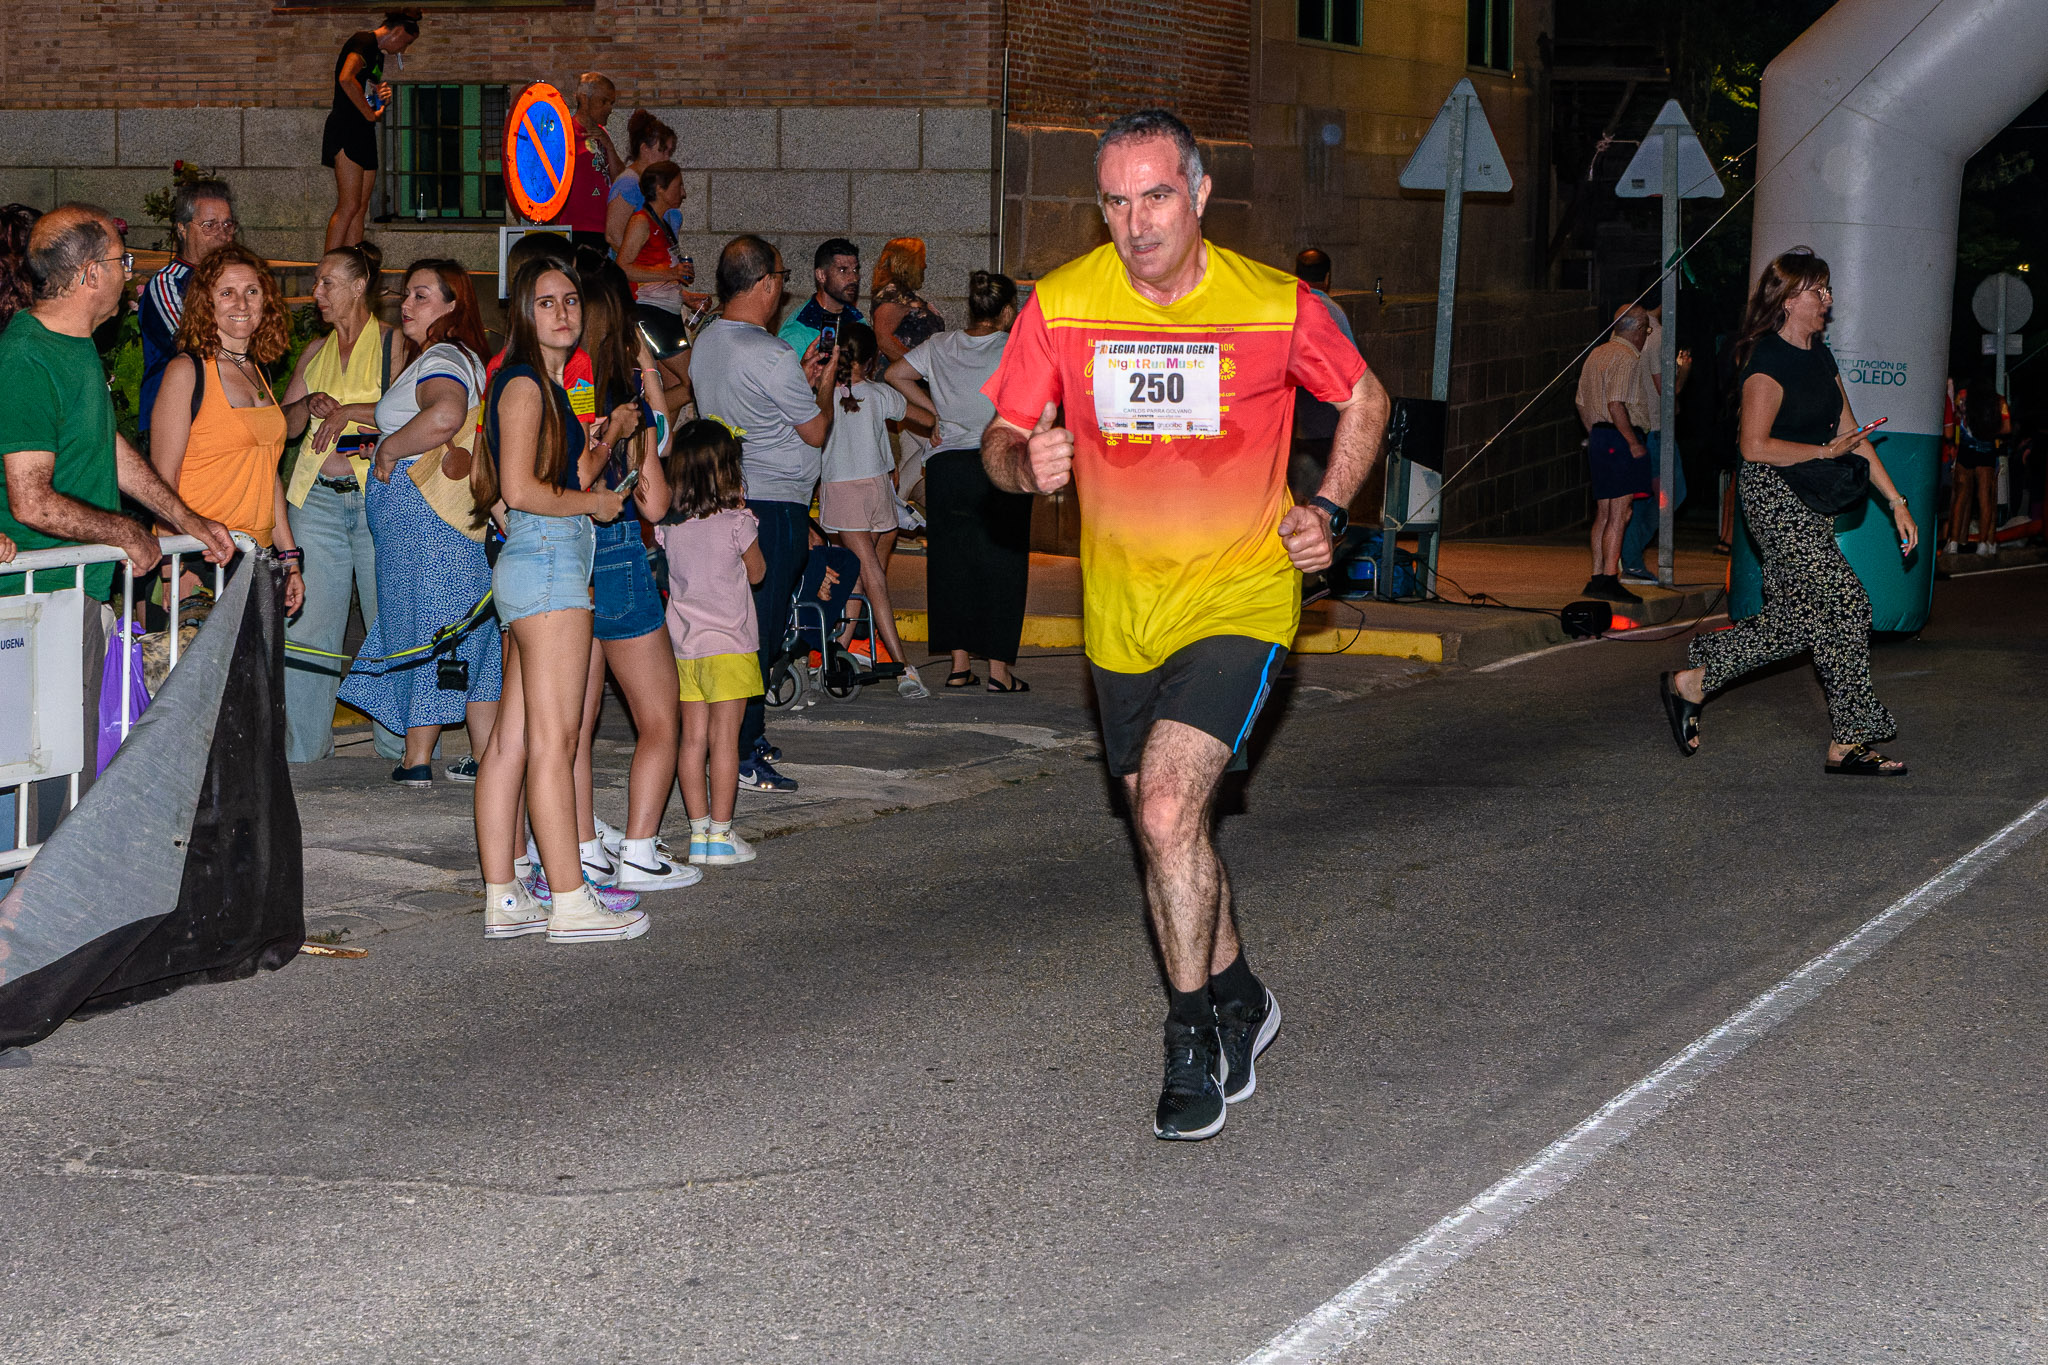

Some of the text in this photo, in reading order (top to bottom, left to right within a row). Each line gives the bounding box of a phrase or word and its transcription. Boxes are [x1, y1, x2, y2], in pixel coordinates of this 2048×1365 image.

[1108, 344, 1135, 354] LEGUA
[1137, 344, 1184, 354] NOCTURNA
[1186, 344, 1215, 354] UGENA
[1220, 343, 1235, 352] 10K
[1896, 362, 1908, 371] DE
[1844, 369, 1907, 386] OLEDO
[1129, 372, 1185, 404] 250
[0, 638, 25, 650] UGENA
